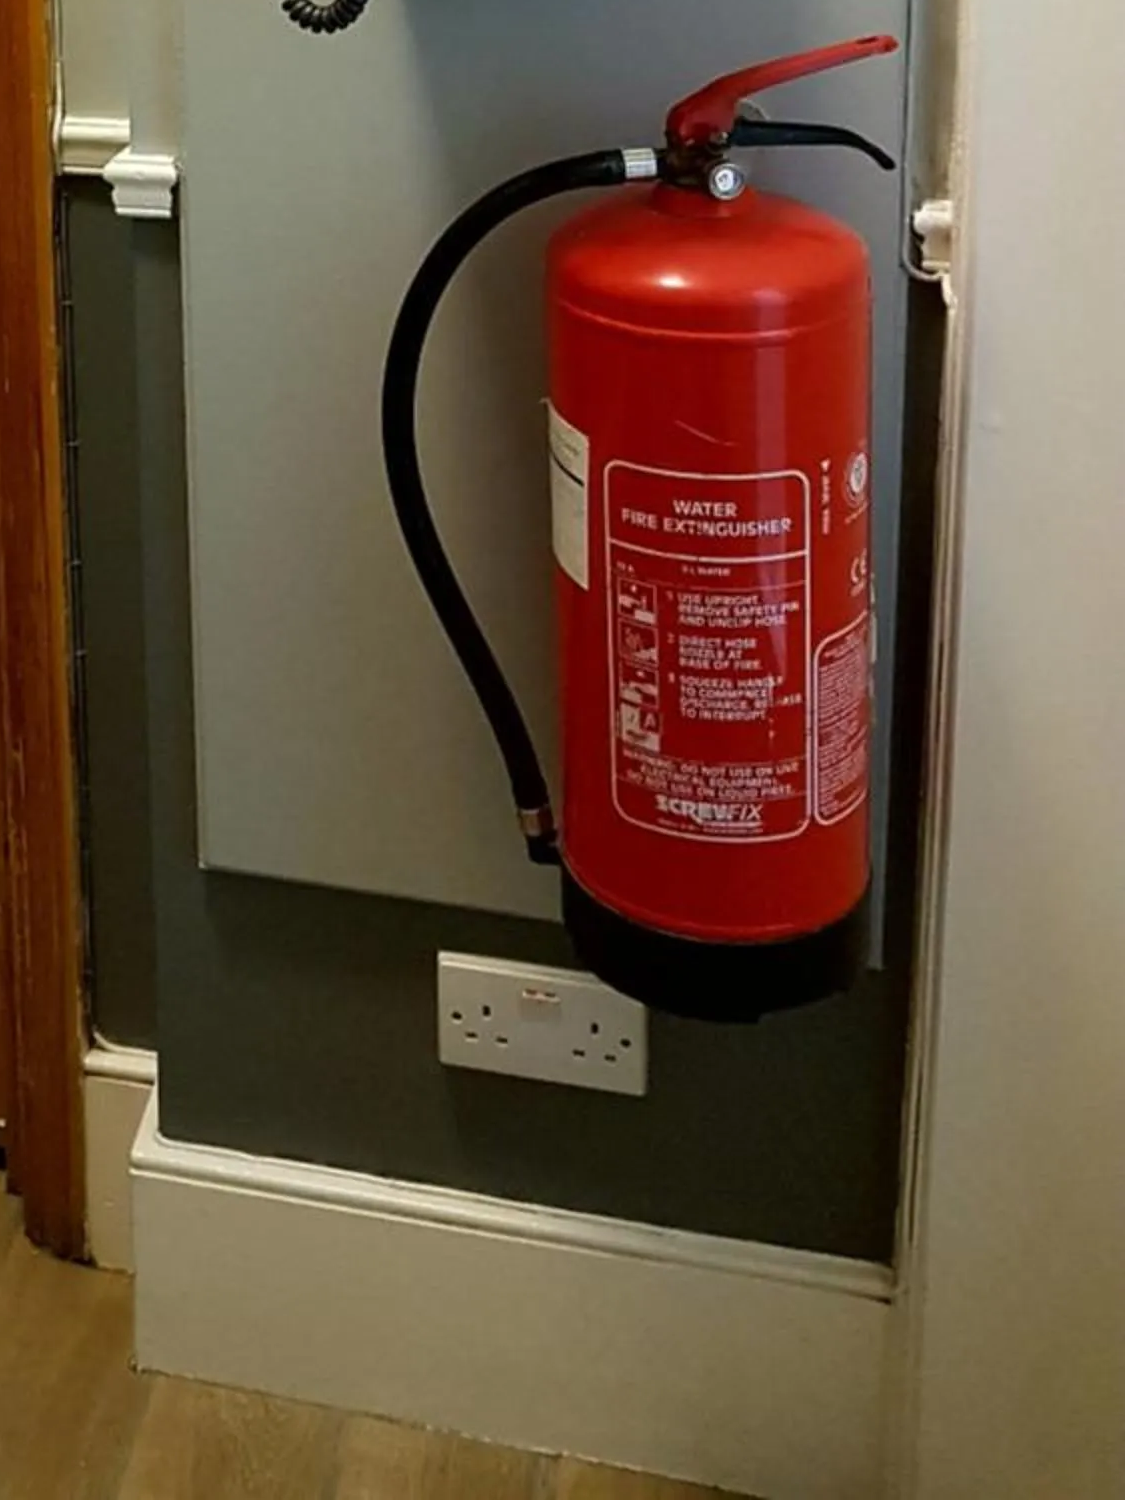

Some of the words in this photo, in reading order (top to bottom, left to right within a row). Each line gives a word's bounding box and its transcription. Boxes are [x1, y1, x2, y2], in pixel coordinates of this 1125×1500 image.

[620, 507, 658, 529] FIRE
[662, 516, 793, 537] EXTINGUISHER
[672, 499, 738, 518] WATER
[655, 794, 763, 822] SCREWFIX
